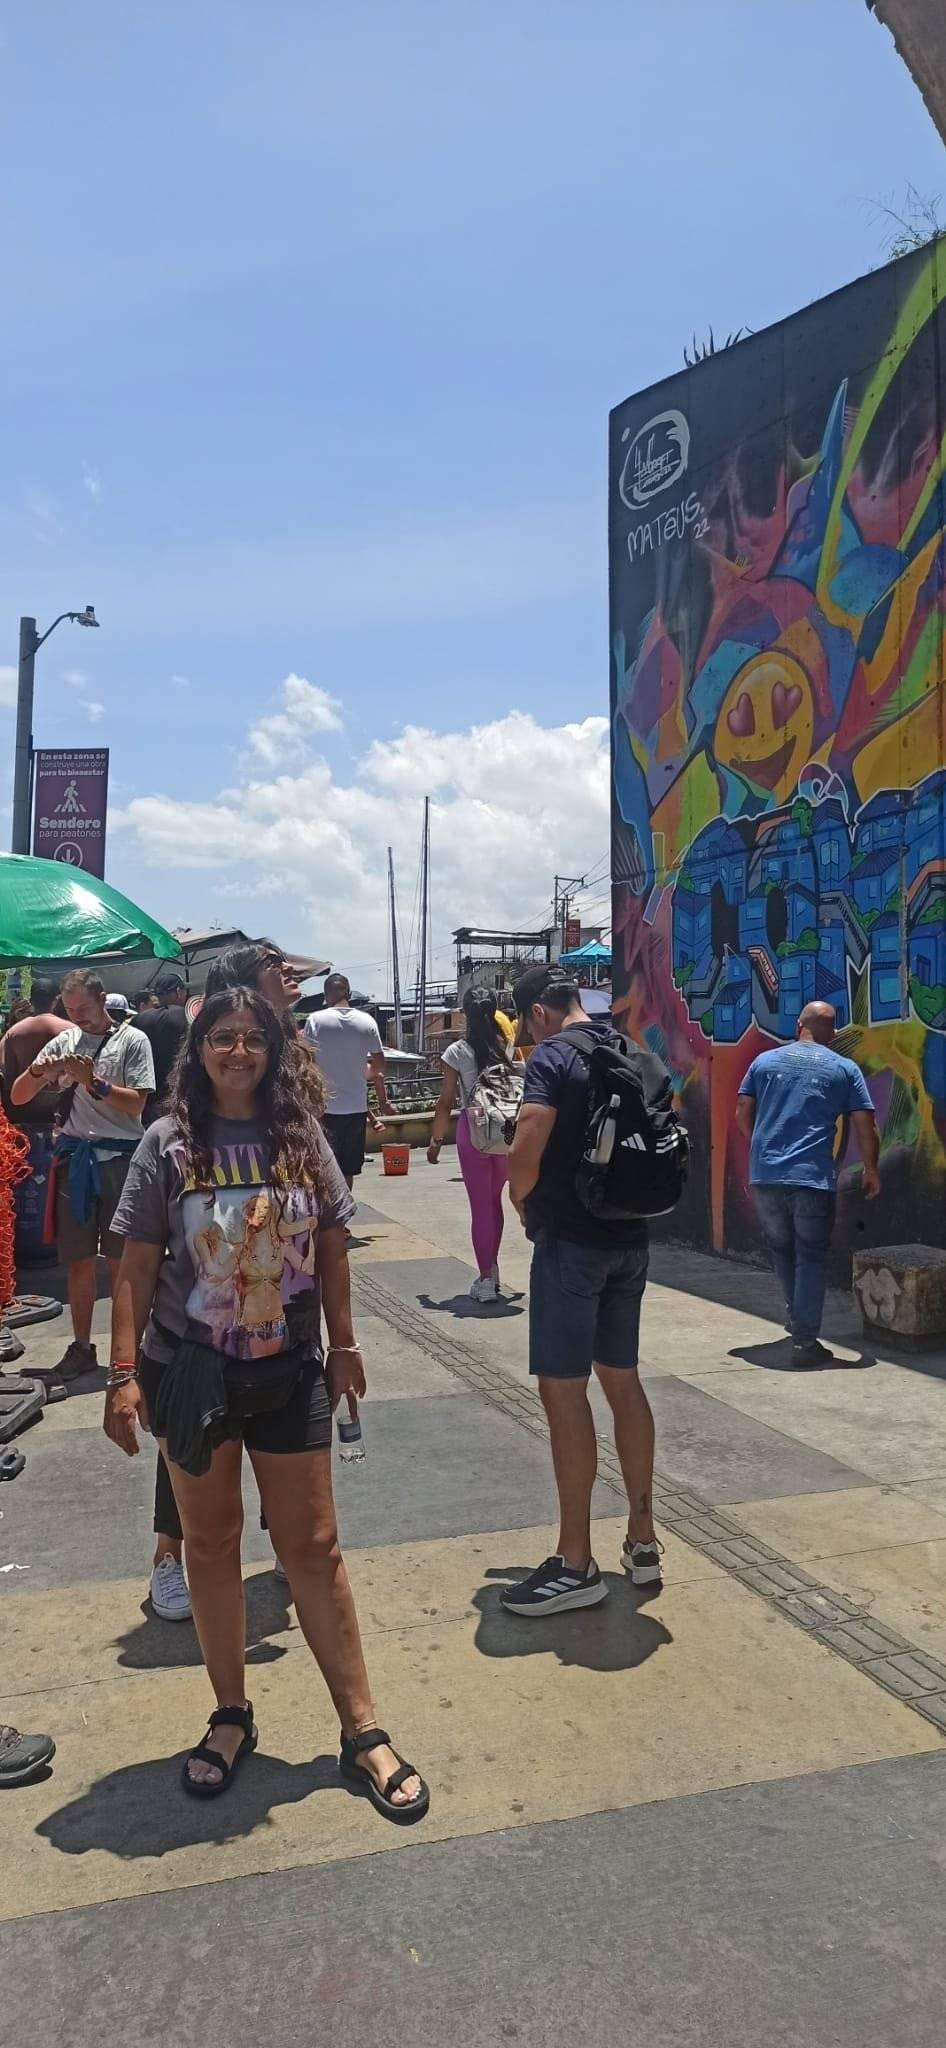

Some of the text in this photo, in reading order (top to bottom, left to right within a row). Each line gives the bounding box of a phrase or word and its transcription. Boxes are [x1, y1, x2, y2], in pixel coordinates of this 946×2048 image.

[693, 518, 711, 539] 22
[40, 761, 75, 769] construye
[39, 817, 101, 829] Sendero
[39, 830, 102, 838] para peatones
